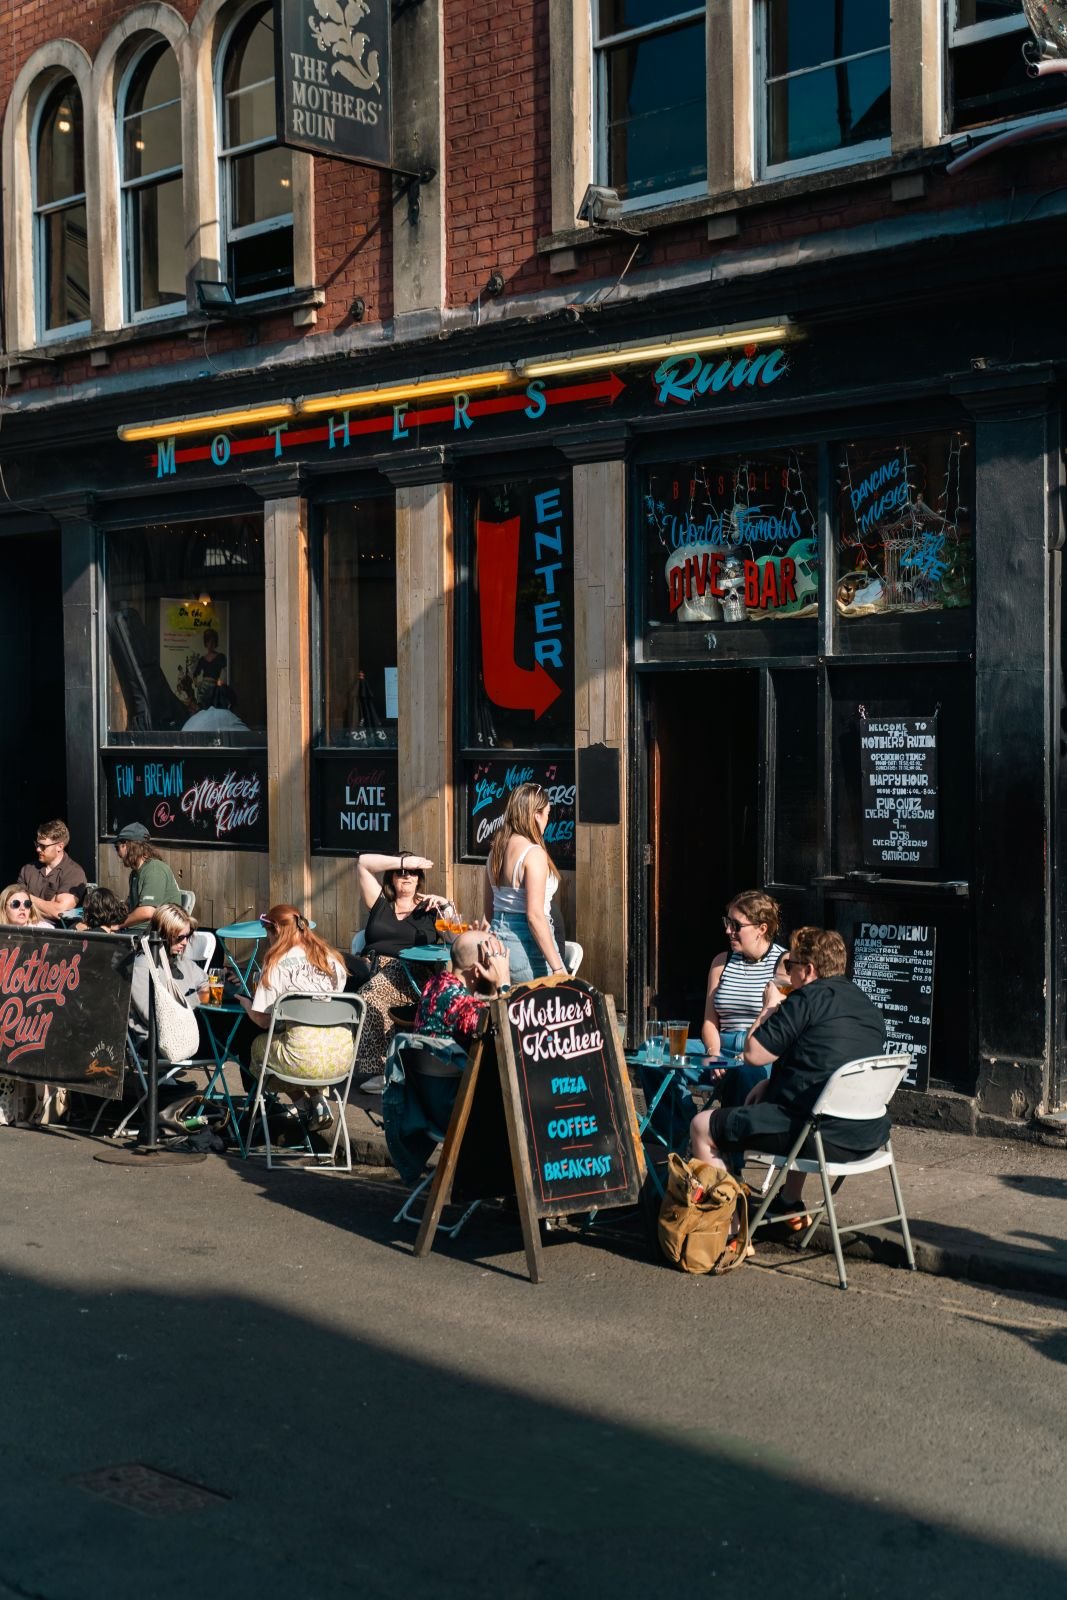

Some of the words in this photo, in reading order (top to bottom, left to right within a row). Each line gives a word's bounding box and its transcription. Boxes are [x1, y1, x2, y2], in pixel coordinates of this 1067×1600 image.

[290, 52, 328, 86] THE
[292, 80, 382, 125] MOTHERS'
[293, 108, 336, 142] RUIN
[157, 380, 546, 478] MOTHERS
[654, 344, 785, 405] Ruin
[851, 458, 901, 512] DANCING
[860, 481, 909, 534] MUSIC
[662, 512, 727, 549] World
[733, 505, 801, 546] Famous
[534, 487, 563, 668] ENTER
[669, 552, 726, 614] DIVE
[744, 557, 797, 609] BAR
[868, 723, 907, 732] WELCOME
[914, 722, 927, 731] TO
[870, 753, 904, 761] OPENING
[904, 753, 926, 761] TIMES
[116, 764, 134, 799] FUN
[498, 764, 535, 795] Music
[869, 774, 901, 786] HAPPY
[901, 774, 928, 786] HOUR
[345, 786, 386, 806] LATE
[876, 798, 895, 810] PUB
[895, 798, 922, 811] QUIZ
[216, 800, 259, 838] Ruin
[340, 811, 392, 832] NIGHT
[865, 809, 890, 819] EVERY
[896, 810, 935, 819] TUESDAY
[872, 840, 895, 848] EVERY
[881, 851, 920, 862] SATURDAY
[854, 938, 882, 947] MAINS
[861, 923, 897, 939] FOOD
[897, 925, 928, 942] MENU
[920, 985, 932, 994] £5
[508, 992, 592, 1031] Mother's
[0, 997, 54, 1056] Ruin
[522, 1029, 604, 1062] Kitchen
[551, 1075, 588, 1095] PIZZA
[547, 1115, 598, 1139] COFFEE
[543, 1155, 612, 1182] BREAKFAST
